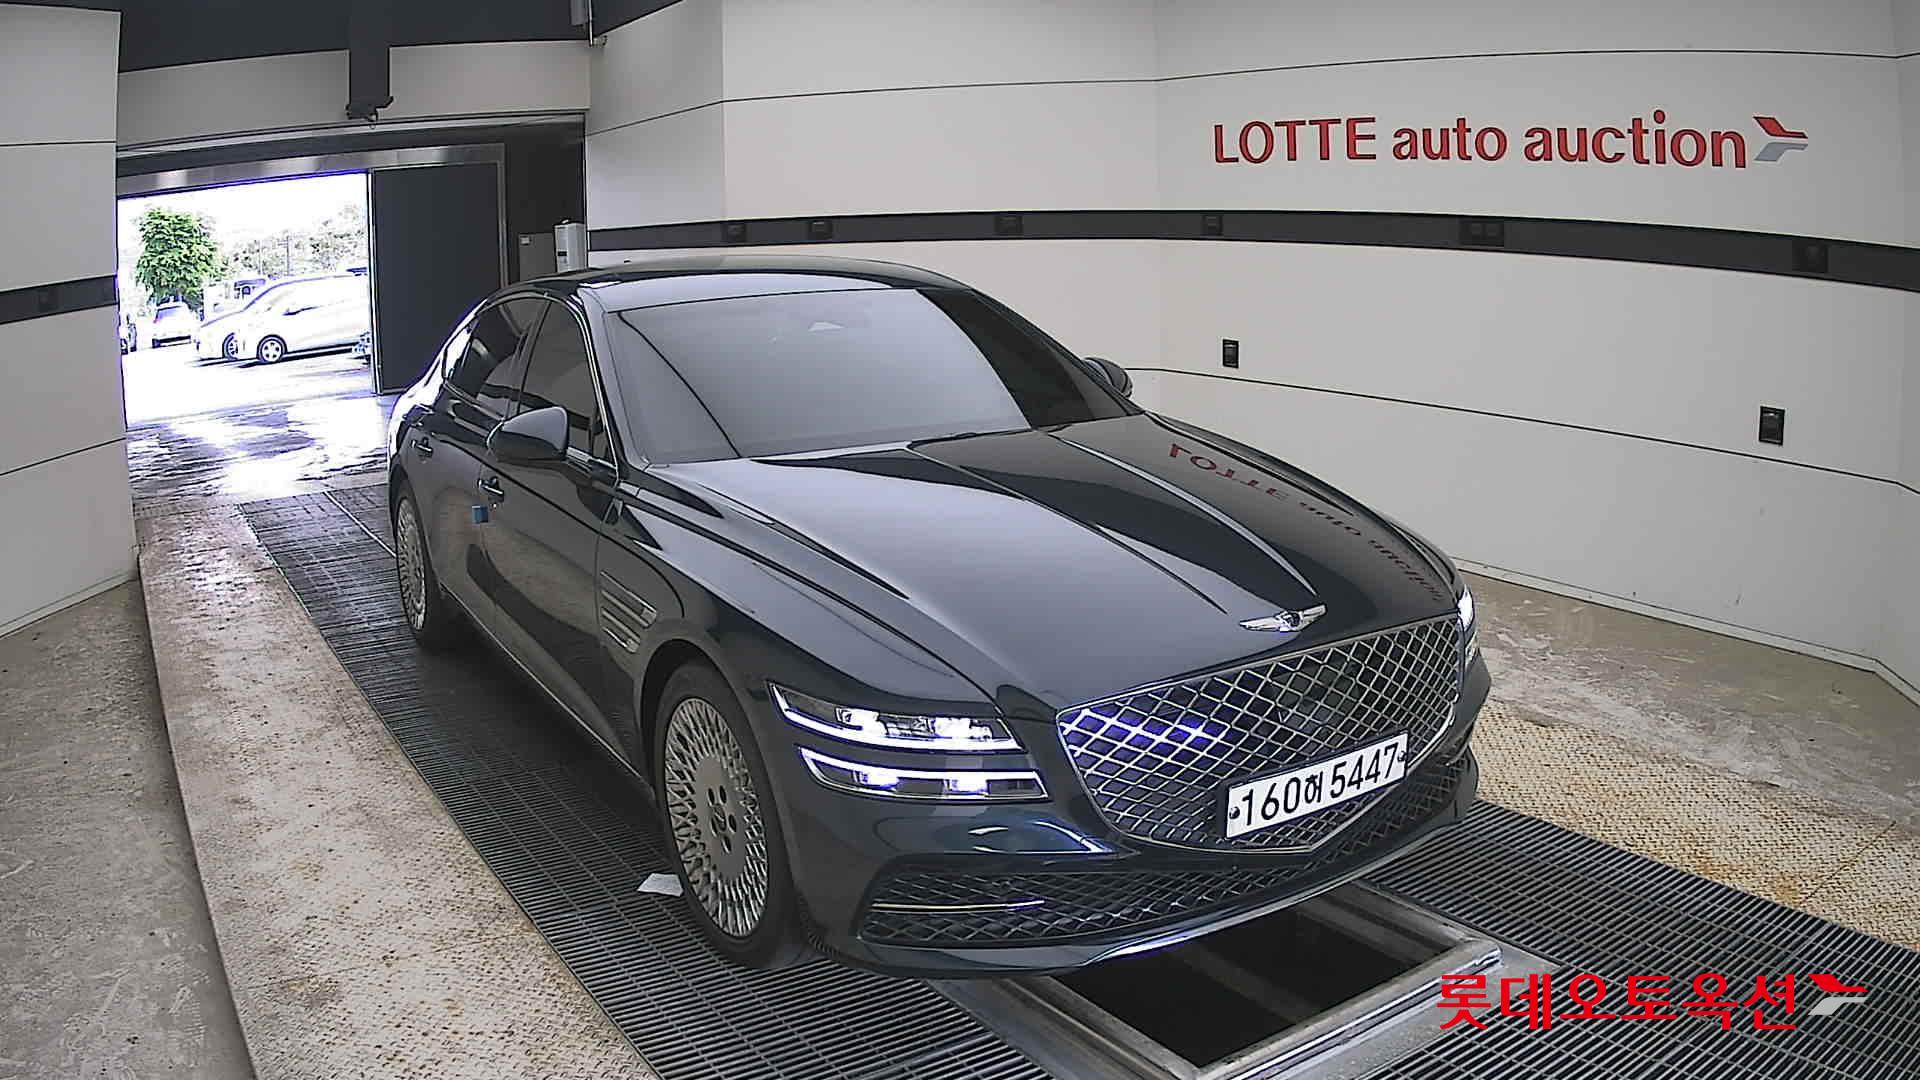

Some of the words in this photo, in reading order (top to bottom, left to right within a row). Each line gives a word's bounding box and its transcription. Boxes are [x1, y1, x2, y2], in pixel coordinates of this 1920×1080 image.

[1213, 116, 1377, 164] LOTTE
[1392, 117, 1508, 162] auto
[1523, 110, 1747, 169] auction
[1242, 770, 1324, 826] 160허
[1329, 741, 1400, 799] 5447
